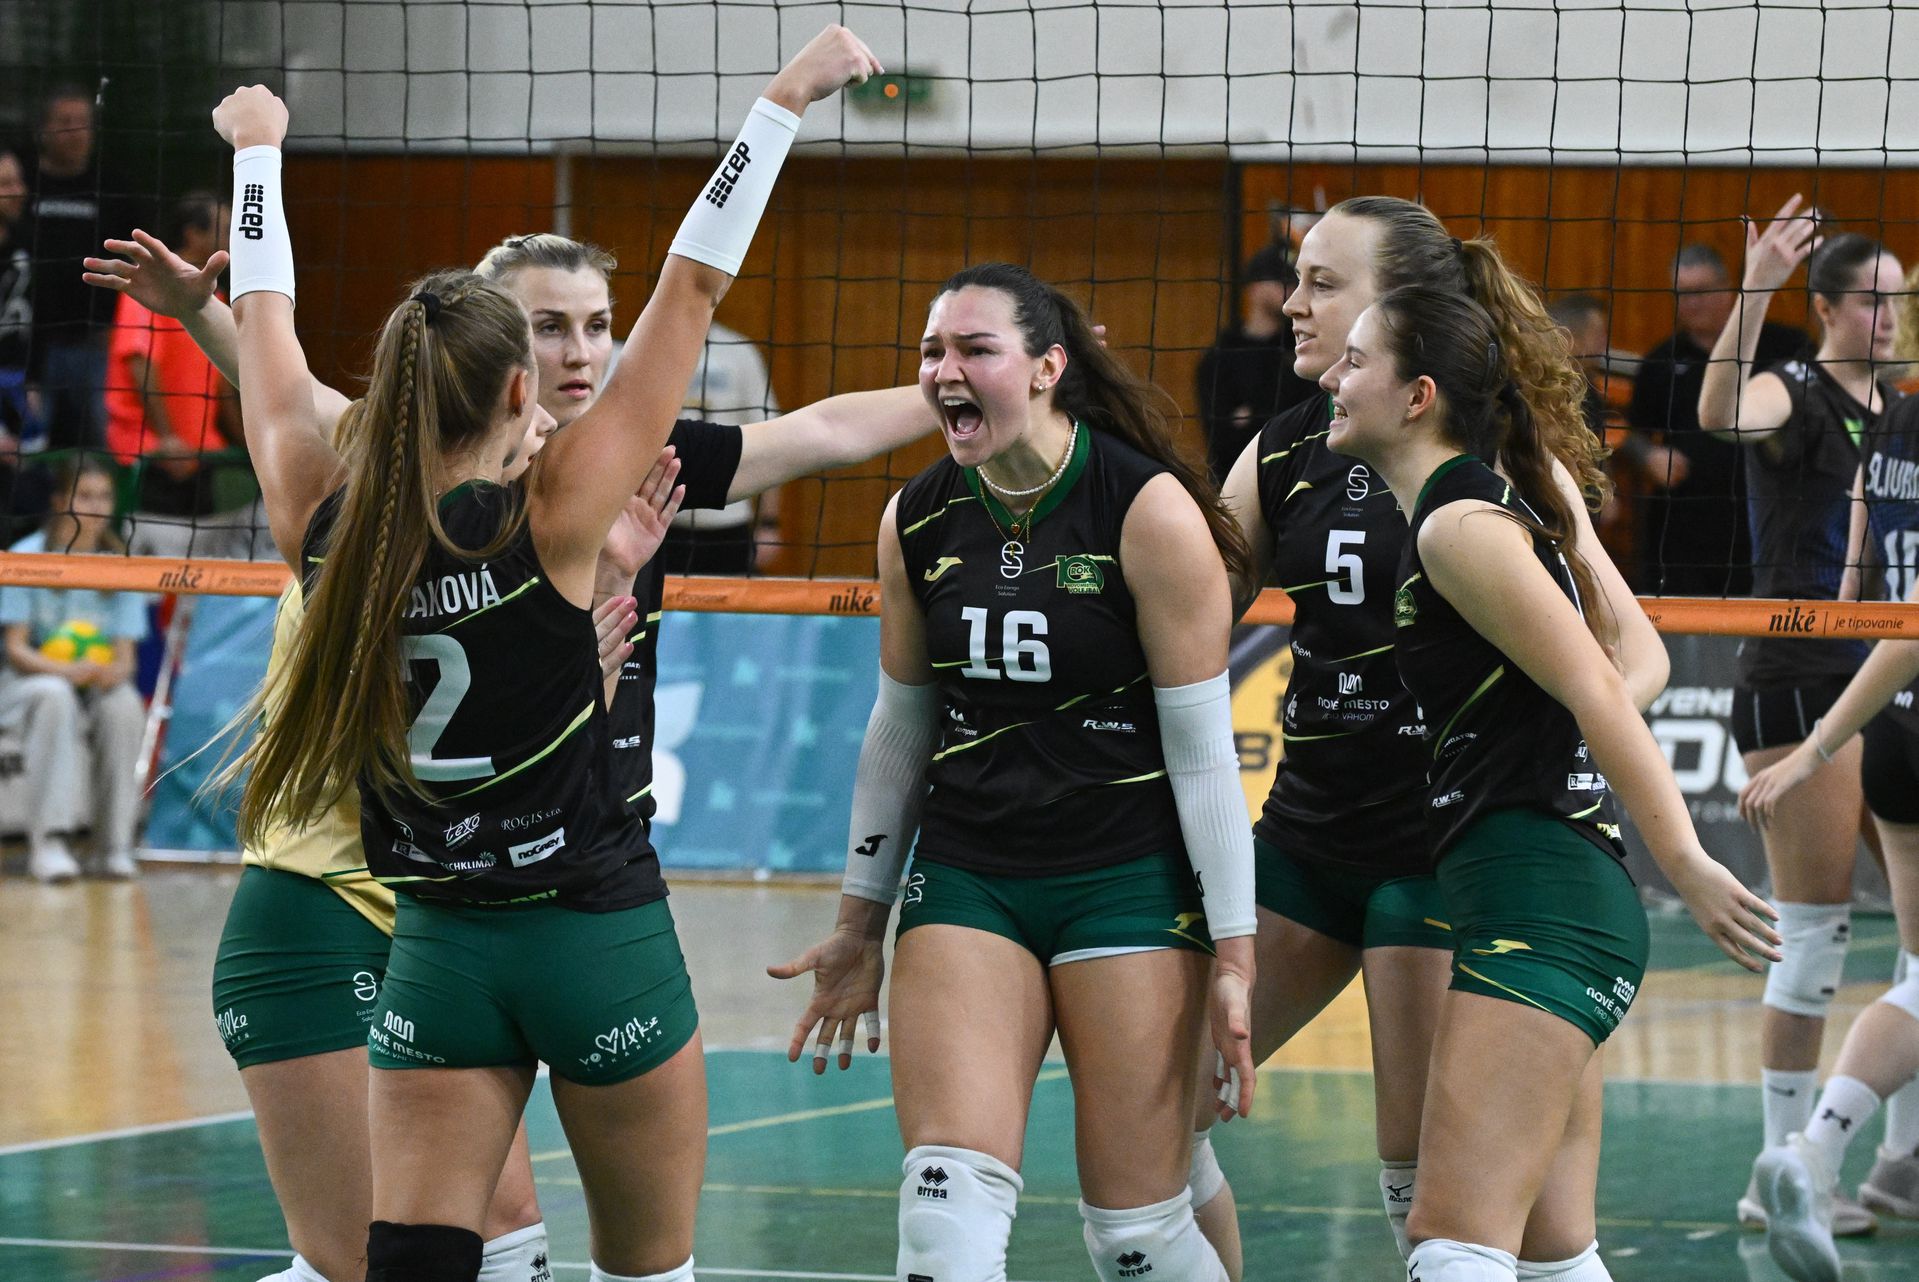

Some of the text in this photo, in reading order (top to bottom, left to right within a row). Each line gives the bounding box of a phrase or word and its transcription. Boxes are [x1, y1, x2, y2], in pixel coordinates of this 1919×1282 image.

[720, 141, 752, 186] cep
[238, 202, 264, 241] cep
[158, 564, 204, 590] niké
[1325, 529, 1367, 606] 5
[402, 562, 503, 619] AKOVÁ
[827, 586, 874, 613] niké
[1768, 605, 1905, 633] niké je tipovanie
[960, 605, 1052, 683] 16
[400, 633, 497, 783] 2
[500, 810, 543, 832] ROGIS
[917, 1185, 949, 1200] errea
[1117, 1263, 1153, 1278] errea
